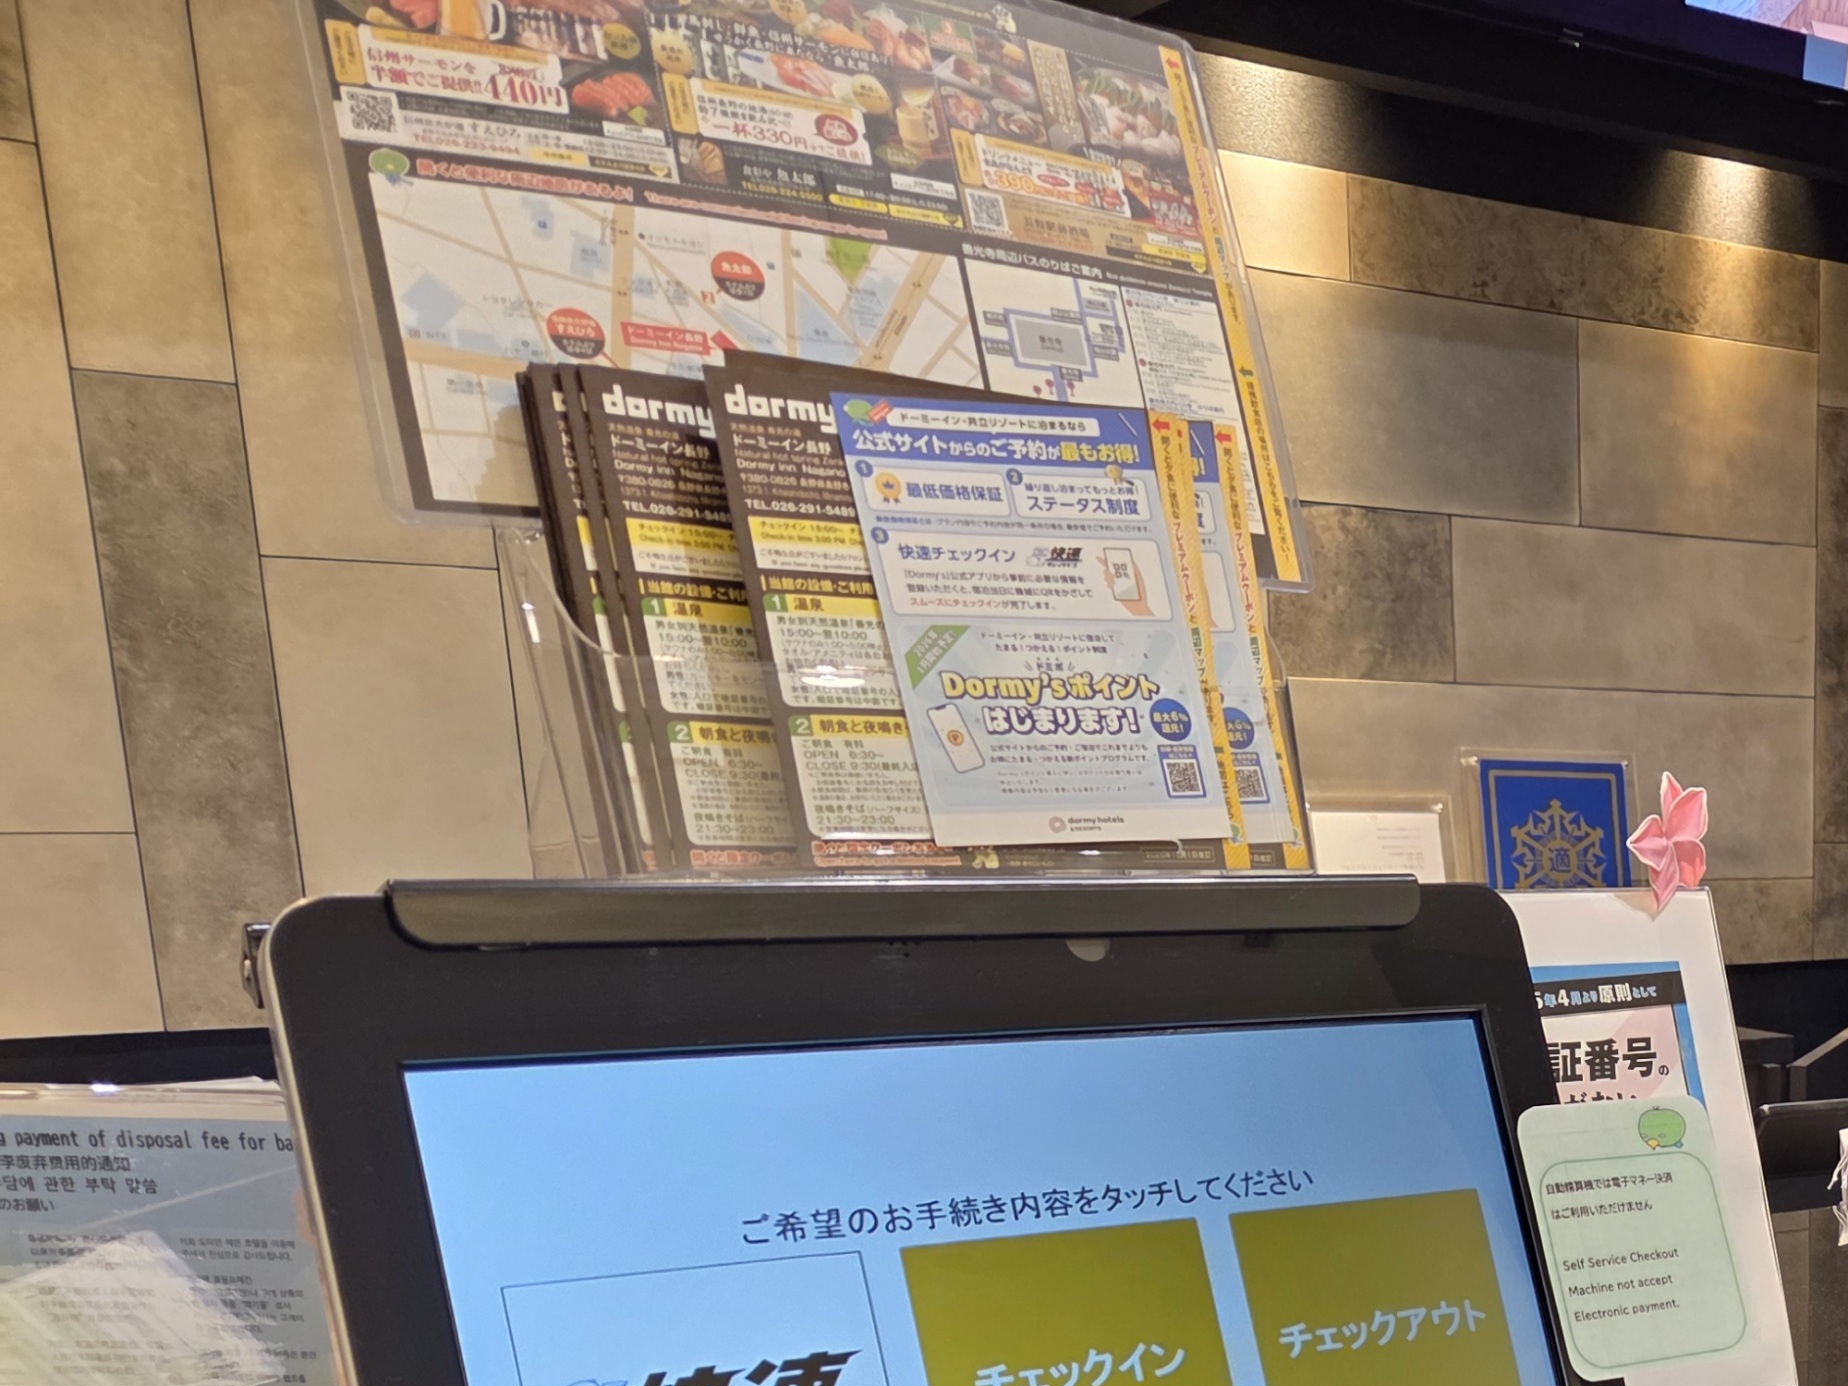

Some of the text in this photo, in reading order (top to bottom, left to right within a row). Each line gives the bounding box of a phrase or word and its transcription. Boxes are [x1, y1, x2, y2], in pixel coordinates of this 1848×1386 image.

[602, 384, 716, 438] dormy
[725, 384, 839, 434] dormy
[611, 434, 710, 460] ドーミーイン長野
[733, 434, 831, 455] ドーミーイン長野
[852, 429, 1140, 464] 公式サイトからのご予約が最もお得!
[737, 458, 775, 474] Dormy
[802, 463, 846, 478] Nagano
[906, 482, 1003, 502] 最低価格保証
[1028, 496, 1140, 515] ステータス制度
[898, 544, 1016, 563] 快速チェックイン
[673, 602, 702, 617] 温泉
[772, 594, 781, 611] 1
[794, 597, 824, 611] 温泉
[939, 670, 1160, 706] Dormy'sポイント
[796, 718, 810, 734] 2
[819, 720, 904, 734] 朝食と夜鳴き
[981, 706, 1141, 736] はじまります!
[674, 724, 690, 741] 2
[804, 751, 839, 759] OPEN
[1549, 846, 1571, 872] 適
[15, 1129, 294, 1152] payment of disposal fee for ba
[0, 1176, 158, 1195] 담에 관한 부탁 말씀
[1546, 1172, 1672, 1195] 自動精算機では電子マネー決済
[0, 1198, 55, 1212] のお願い
[742, 1167, 1314, 1246] ご希望のお手続き内容をタッチしてください
[1551, 1201, 1653, 1220] はご利用いただけません
[1562, 1248, 1679, 1272] Self Service Checkout
[1568, 1274, 1673, 1297] Machine not accept
[1574, 1299, 1680, 1323] Electronic payment.
[1277, 1298, 1487, 1359] チェックアウト
